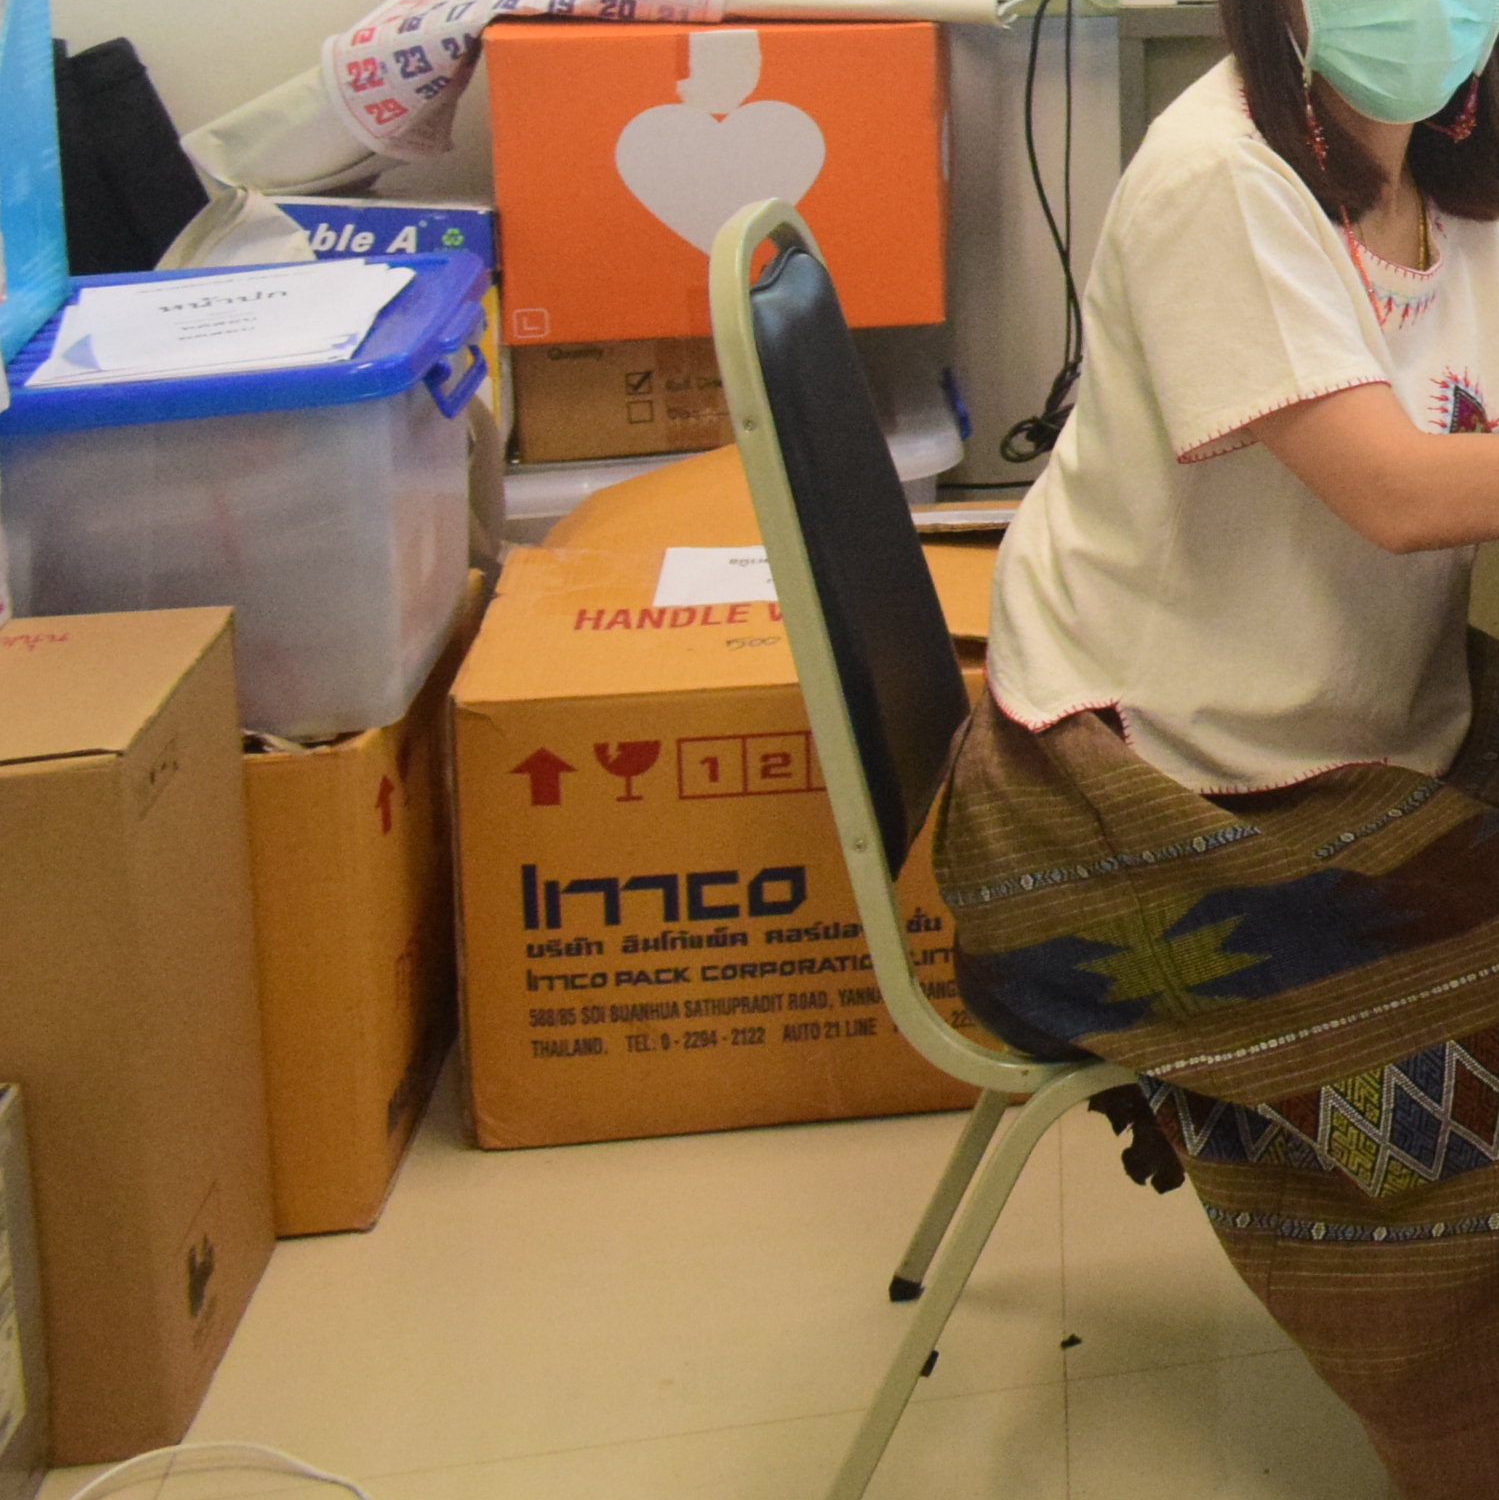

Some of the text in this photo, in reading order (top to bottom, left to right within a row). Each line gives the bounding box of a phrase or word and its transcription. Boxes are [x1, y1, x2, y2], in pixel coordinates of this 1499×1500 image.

[346, 57, 386, 92] 22
[394, 45, 433, 80] 23
[364, 98, 409, 126] 29
[307, 223, 419, 254] ble A
[573, 603, 751, 631] HANDLE
[700, 752, 793, 783] 1 2
[526, 936, 604, 959] บริษัท
[614, 966, 690, 987] PACK
[844, 1017, 878, 1039] LINE
